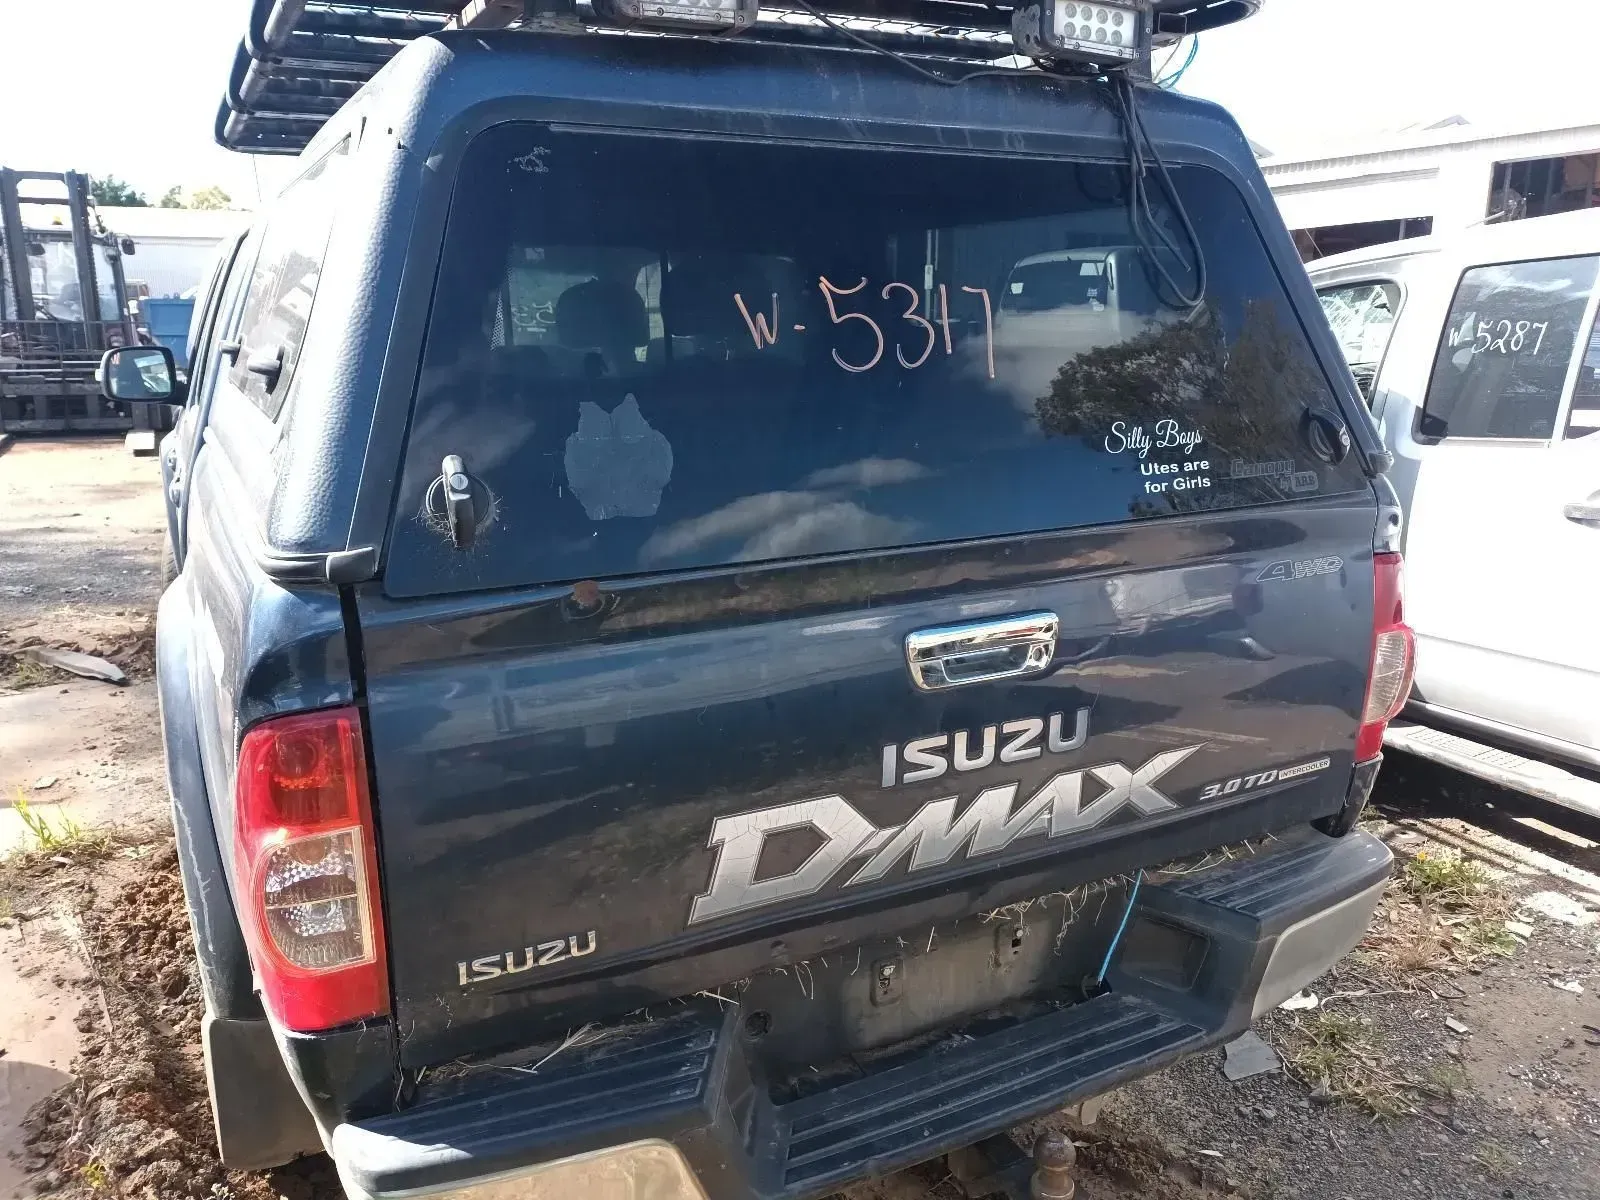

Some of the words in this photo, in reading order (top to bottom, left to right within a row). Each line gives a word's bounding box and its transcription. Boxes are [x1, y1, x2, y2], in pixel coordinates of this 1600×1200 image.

[1104, 421, 1152, 459] Silly
[1155, 418, 1203, 455] Boys
[1140, 462, 1179, 476] Utes
[1183, 459, 1210, 472] are
[1230, 458, 1296, 479] Canopy
[1144, 480, 1169, 494] for
[1172, 476, 1211, 491] Girls
[1255, 555, 1344, 582] 4WD
[881, 707, 1090, 788] ISUZU
[1280, 759, 1330, 779] INTERCOOLER
[457, 930, 597, 986] ISUZU
